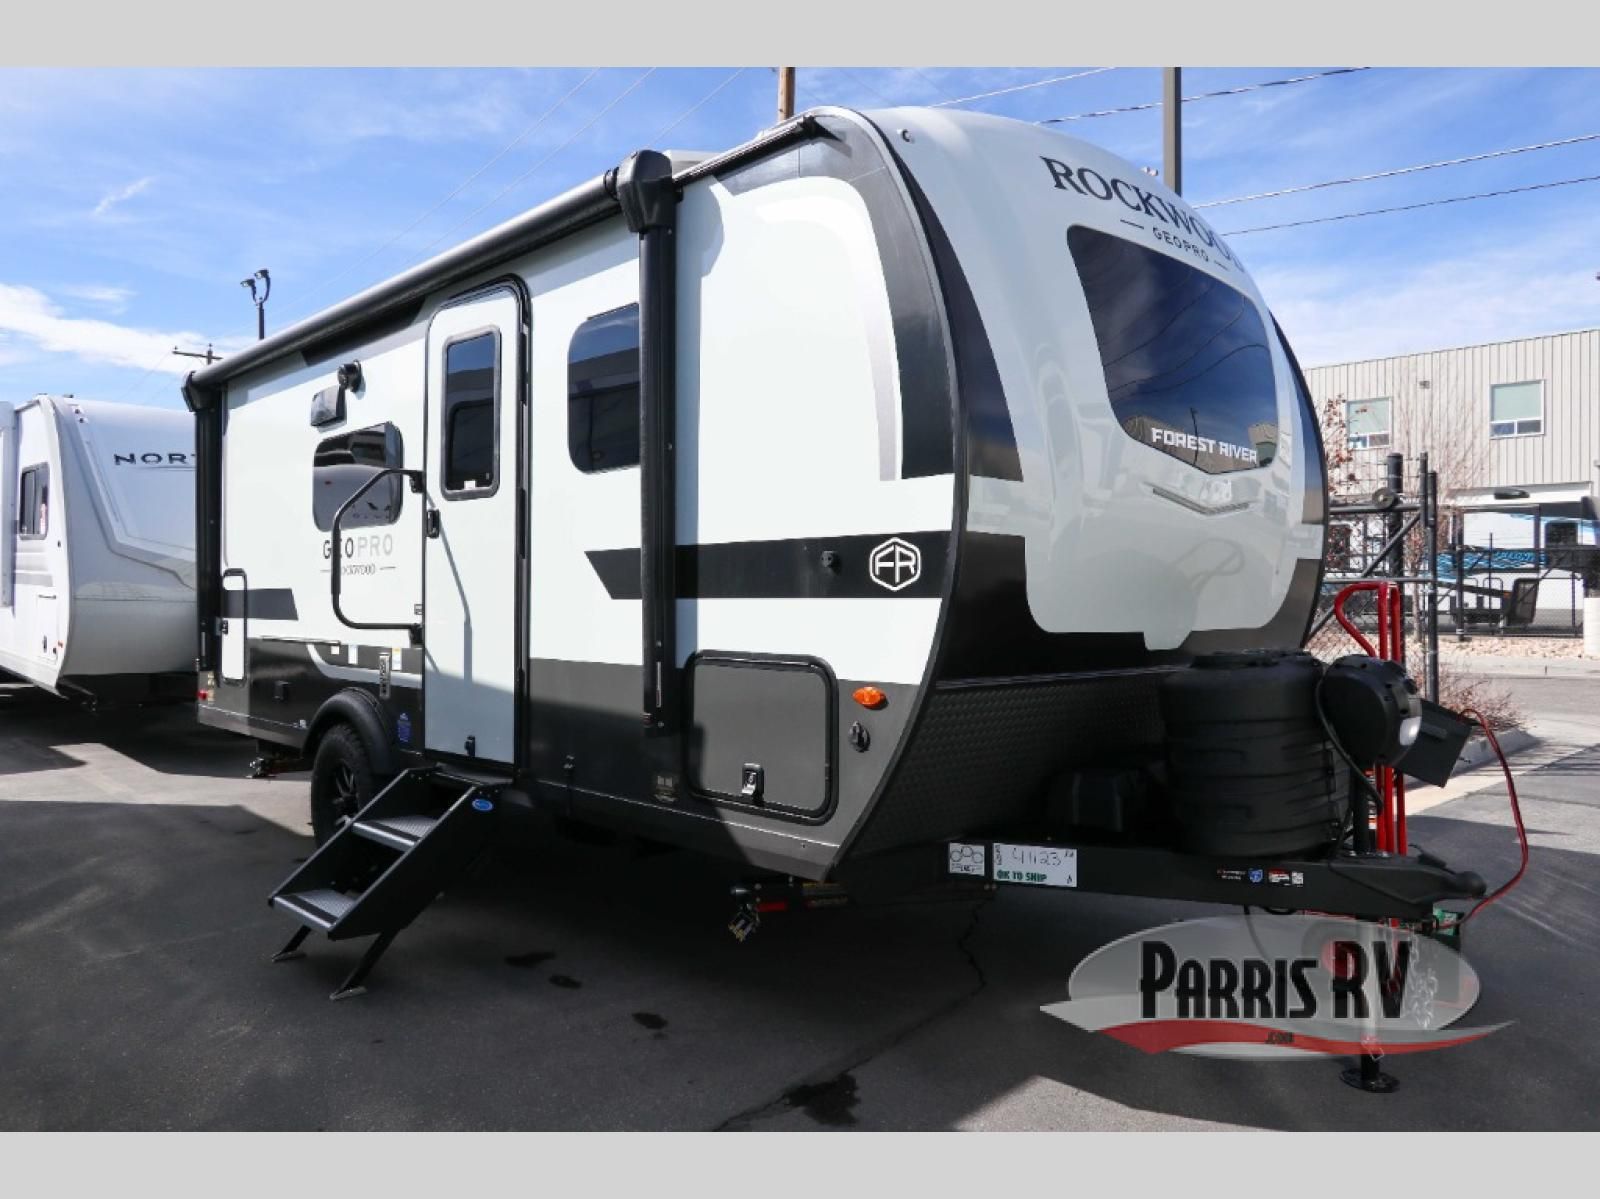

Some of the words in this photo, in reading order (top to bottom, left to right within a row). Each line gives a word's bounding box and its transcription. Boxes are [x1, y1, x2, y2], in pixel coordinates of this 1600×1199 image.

[1152, 226, 1210, 262] GEOPRO
[1151, 427, 1216, 454] FOREST
[1219, 441, 1257, 464] RIVER
[113, 453, 197, 466] NOR
[323, 533, 393, 560] GOPRO
[1012, 871, 1024, 881] TO
[1025, 871, 1048, 883] SHIP
